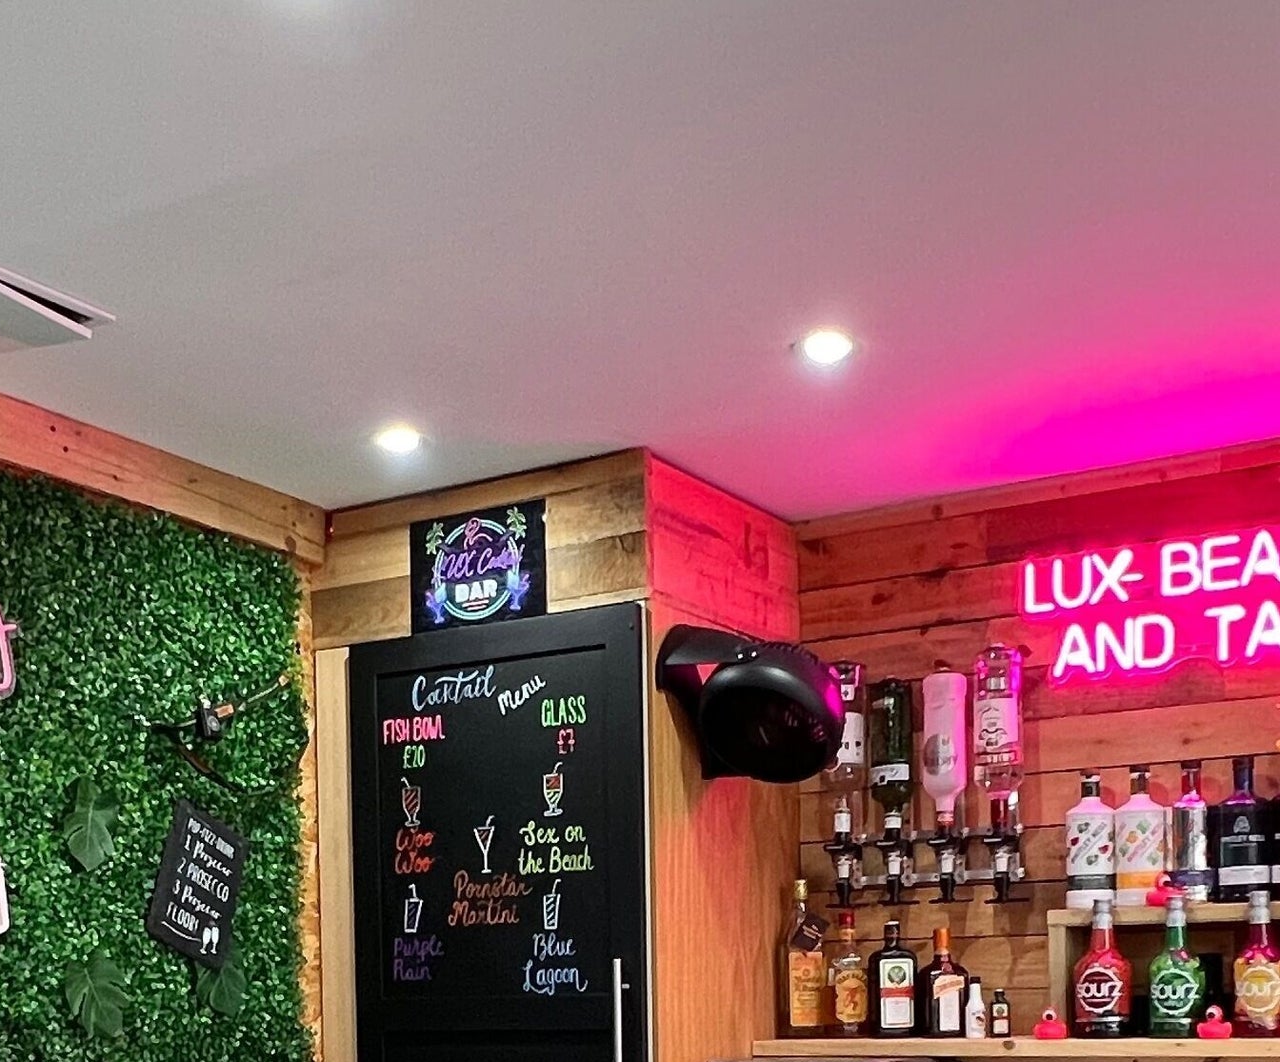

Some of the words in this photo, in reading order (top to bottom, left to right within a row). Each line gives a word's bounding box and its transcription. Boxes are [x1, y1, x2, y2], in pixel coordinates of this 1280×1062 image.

[455, 579, 498, 603] BAR
[1054, 614, 1175, 678] AND
[541, 695, 587, 727] GLASS
[383, 717, 410, 745] FISH
[412, 714, 446, 741] BOWL
[184, 834, 191, 851] 1
[395, 828, 436, 851] Woo
[519, 820, 560, 846] Sex
[565, 825, 586, 843] on
[394, 850, 435, 874] Woo
[518, 854, 545, 876] the
[549, 846, 595, 873] Beach
[172, 879, 181, 895] 3
[177, 856, 187, 874] 2
[186, 863, 229, 902] PROSECCO
[454, 870, 533, 899] Pornstar
[448, 900, 520, 926] Martini
[394, 934, 445, 957] Purple
[533, 933, 575, 962] Blue
[394, 959, 432, 982] Rain
[523, 960, 588, 996] Lagoon
